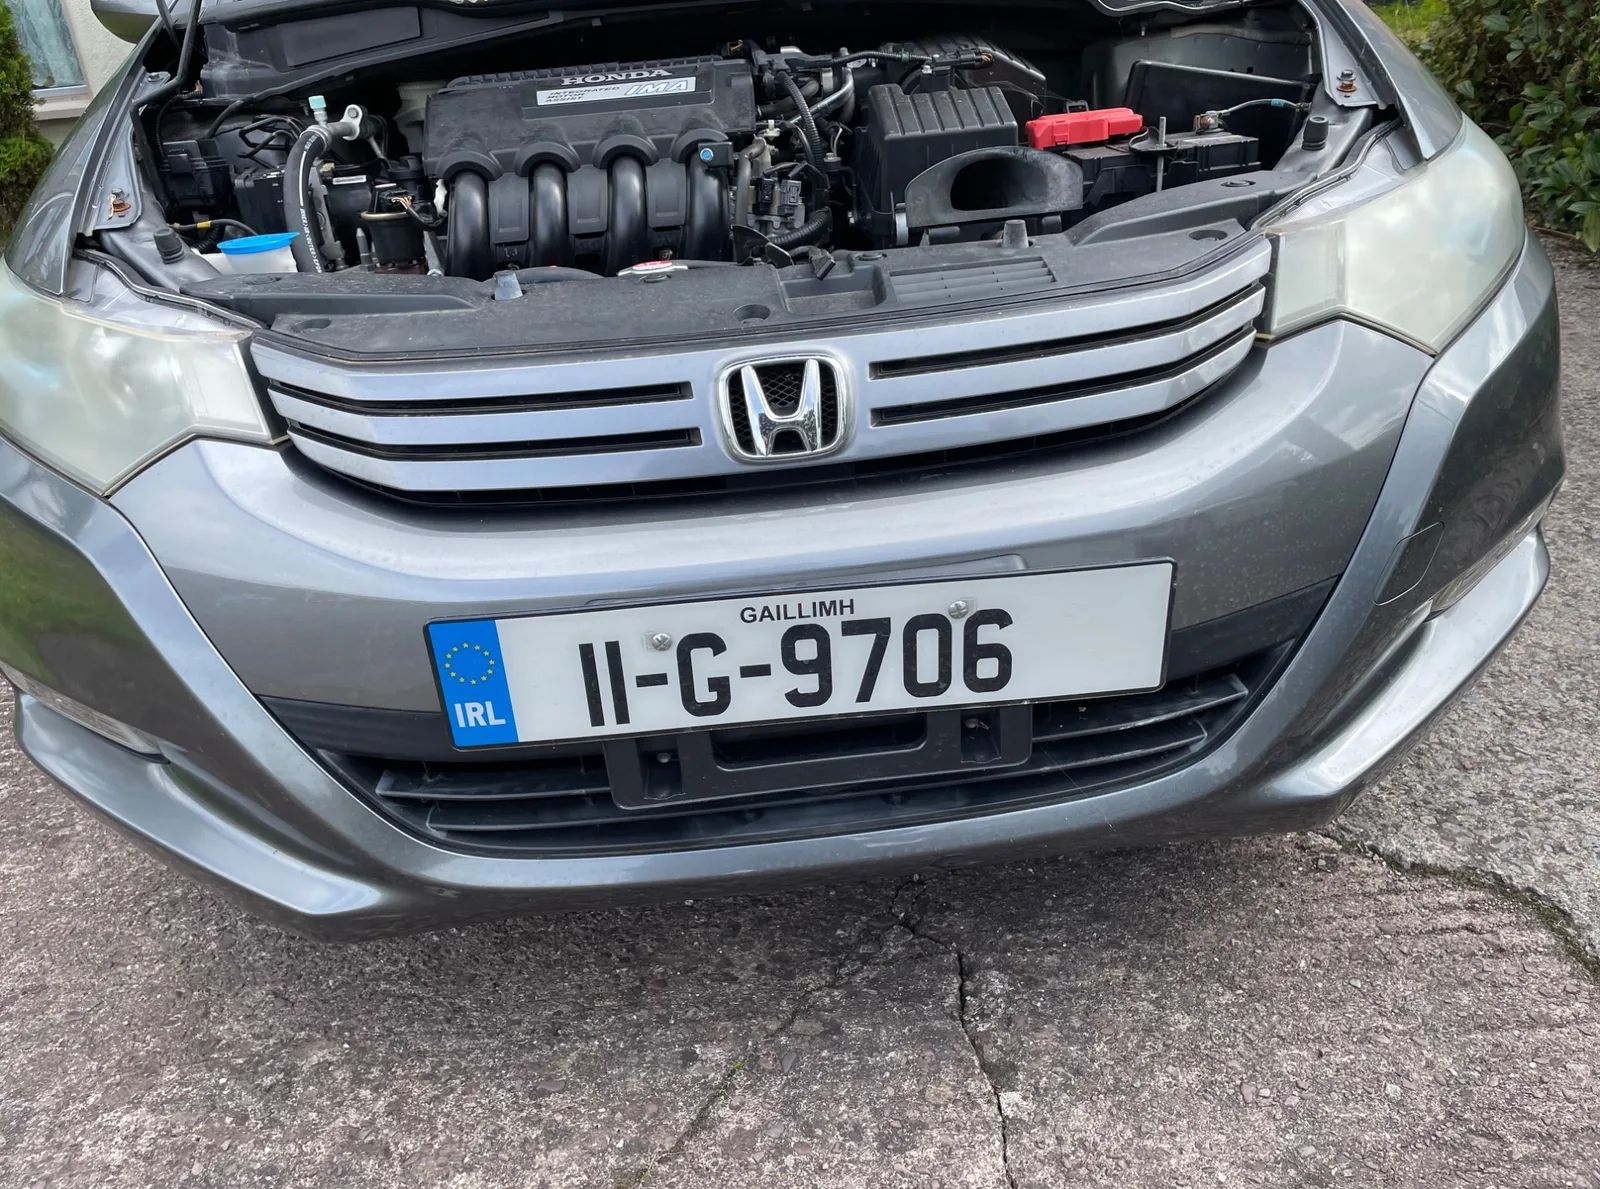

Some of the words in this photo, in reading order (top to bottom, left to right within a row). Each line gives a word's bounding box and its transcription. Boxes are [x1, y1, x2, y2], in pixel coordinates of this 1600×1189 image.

[561, 69, 672, 86] HONDA
[624, 79, 689, 96] IMA
[550, 86, 620, 96] INTEGRATED
[740, 598, 855, 624] GAILLIMH
[578, 608, 1014, 727] 11-G-9706
[454, 700, 506, 728] IRL
